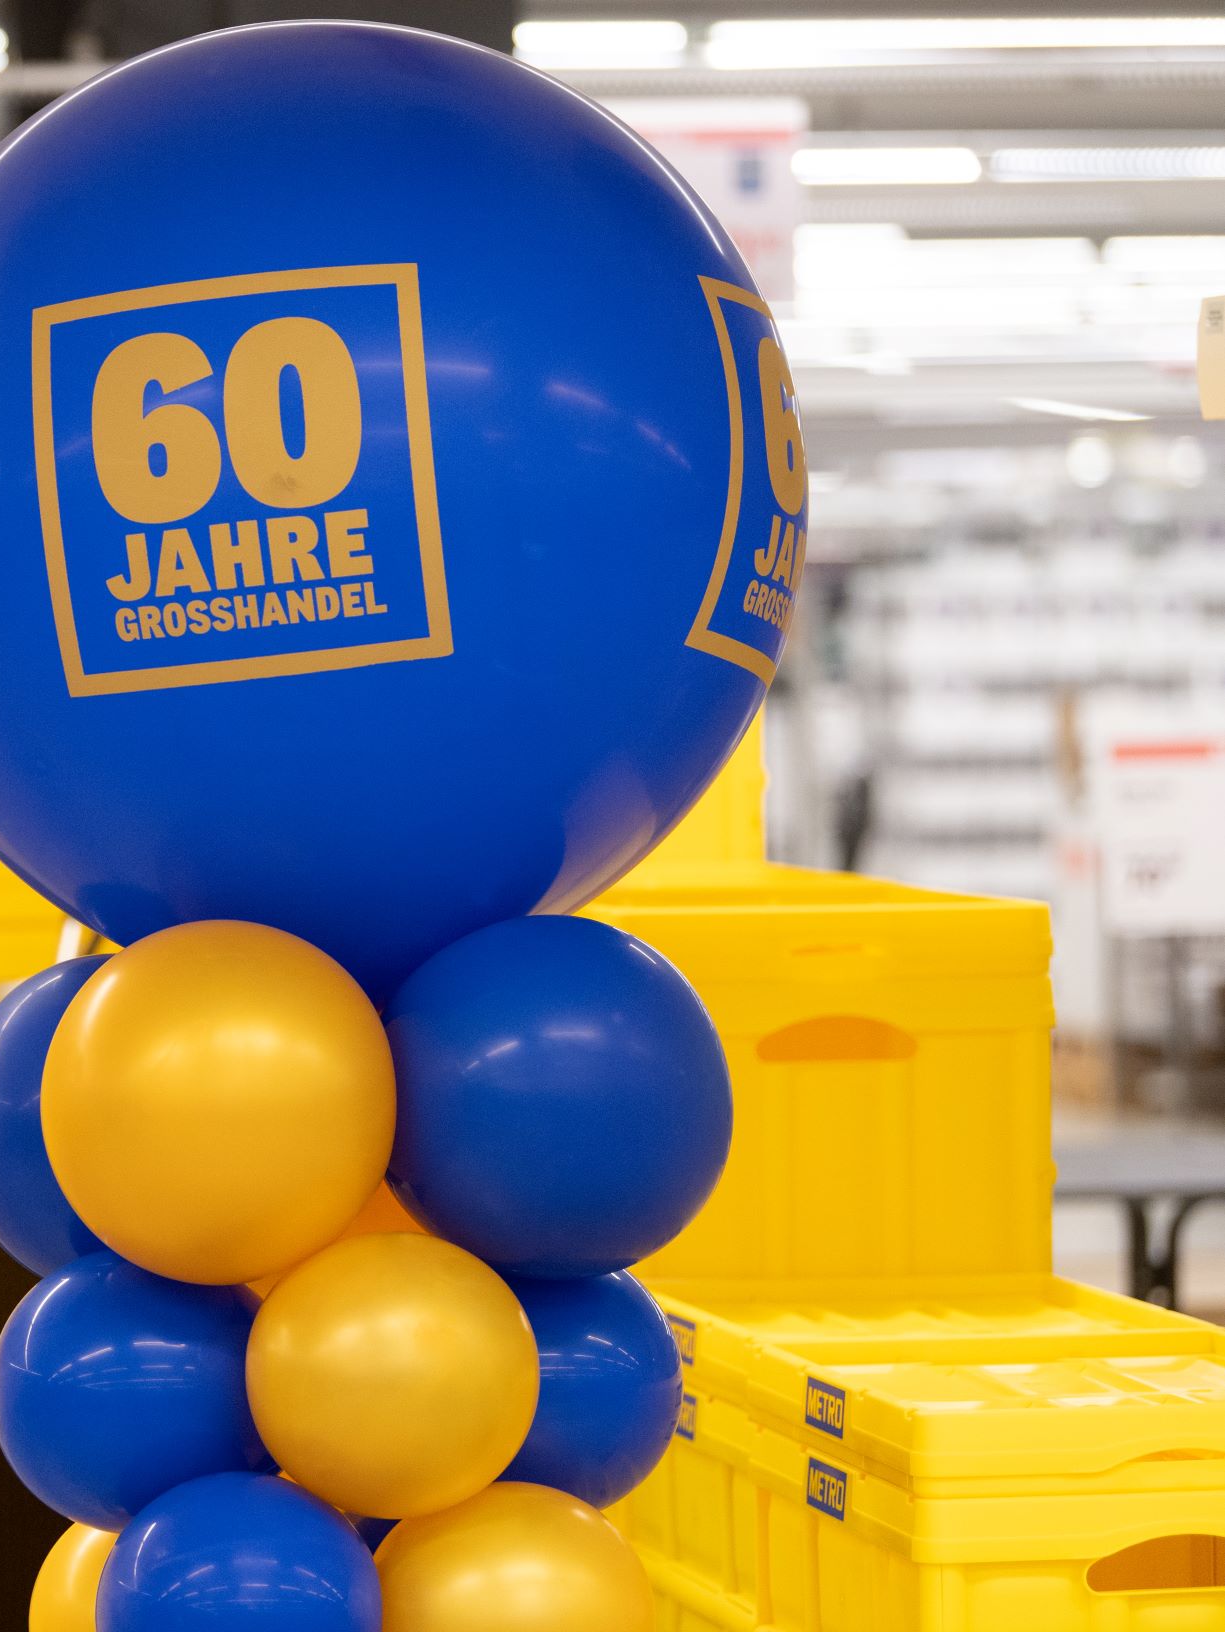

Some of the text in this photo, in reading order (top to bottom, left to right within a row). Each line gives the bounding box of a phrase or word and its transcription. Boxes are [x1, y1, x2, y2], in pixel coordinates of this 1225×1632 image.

[91, 316, 363, 524] 60
[757, 336, 807, 517] 6
[105, 508, 375, 602] JAHRE
[114, 581, 389, 643] GROSSHANDEL
[806, 1385, 843, 1430] METRO
[808, 1466, 845, 1512] METRO
